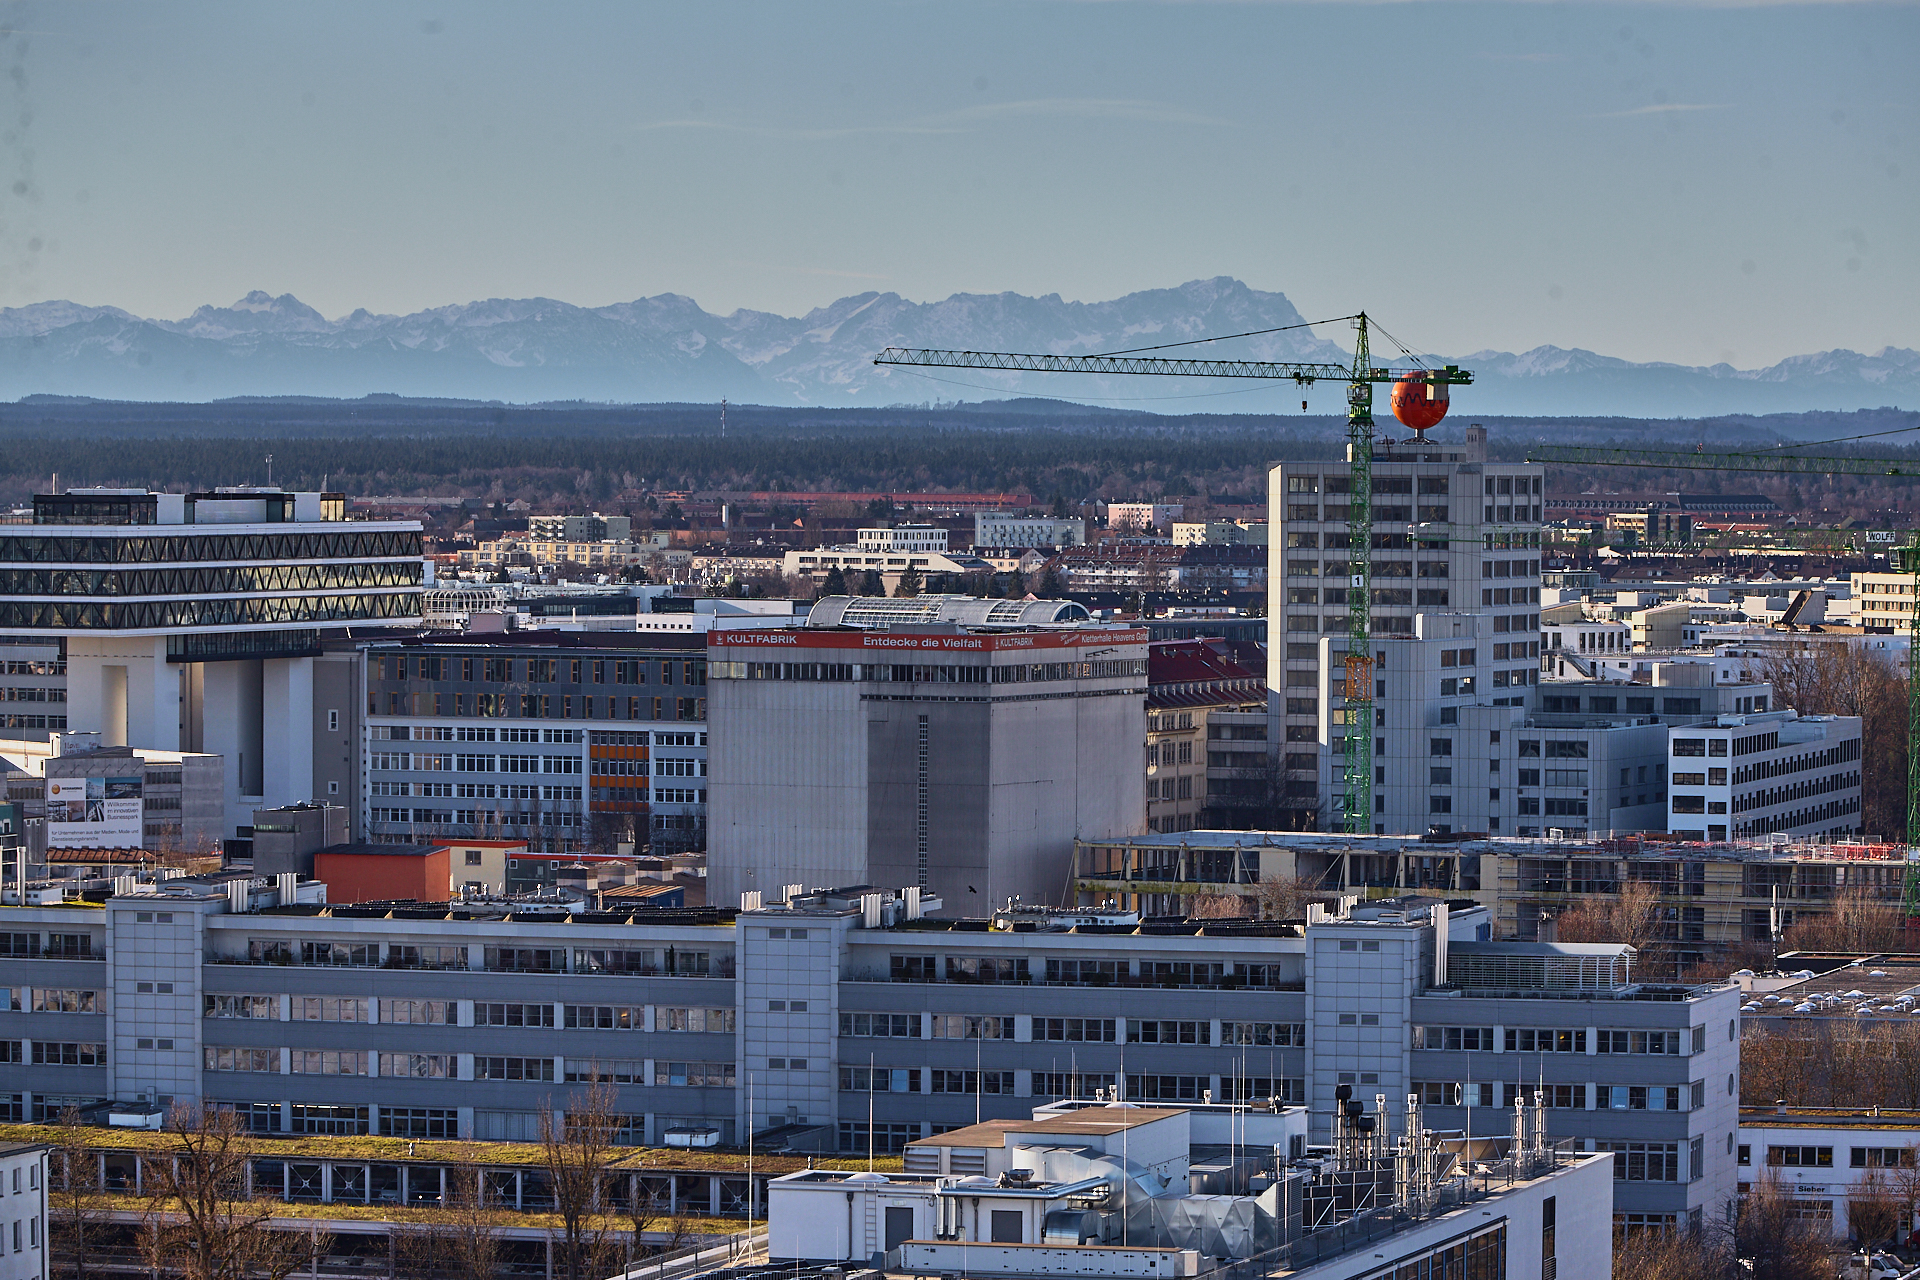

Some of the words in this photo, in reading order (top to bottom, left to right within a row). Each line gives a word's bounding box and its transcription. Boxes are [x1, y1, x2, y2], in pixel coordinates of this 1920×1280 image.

[1869, 532, 1895, 541] WOLFF
[1355, 576, 1360, 586] 1
[726, 634, 797, 644] KULTFABRIK
[863, 637, 918, 647] Entdecke
[921, 638, 939, 647] die
[943, 638, 982, 648] Vielfalt
[1000, 637, 1034, 647] KULTFABRIK
[1082, 634, 1111, 643] Kletterhalle
[1113, 633, 1135, 641] Heavens
